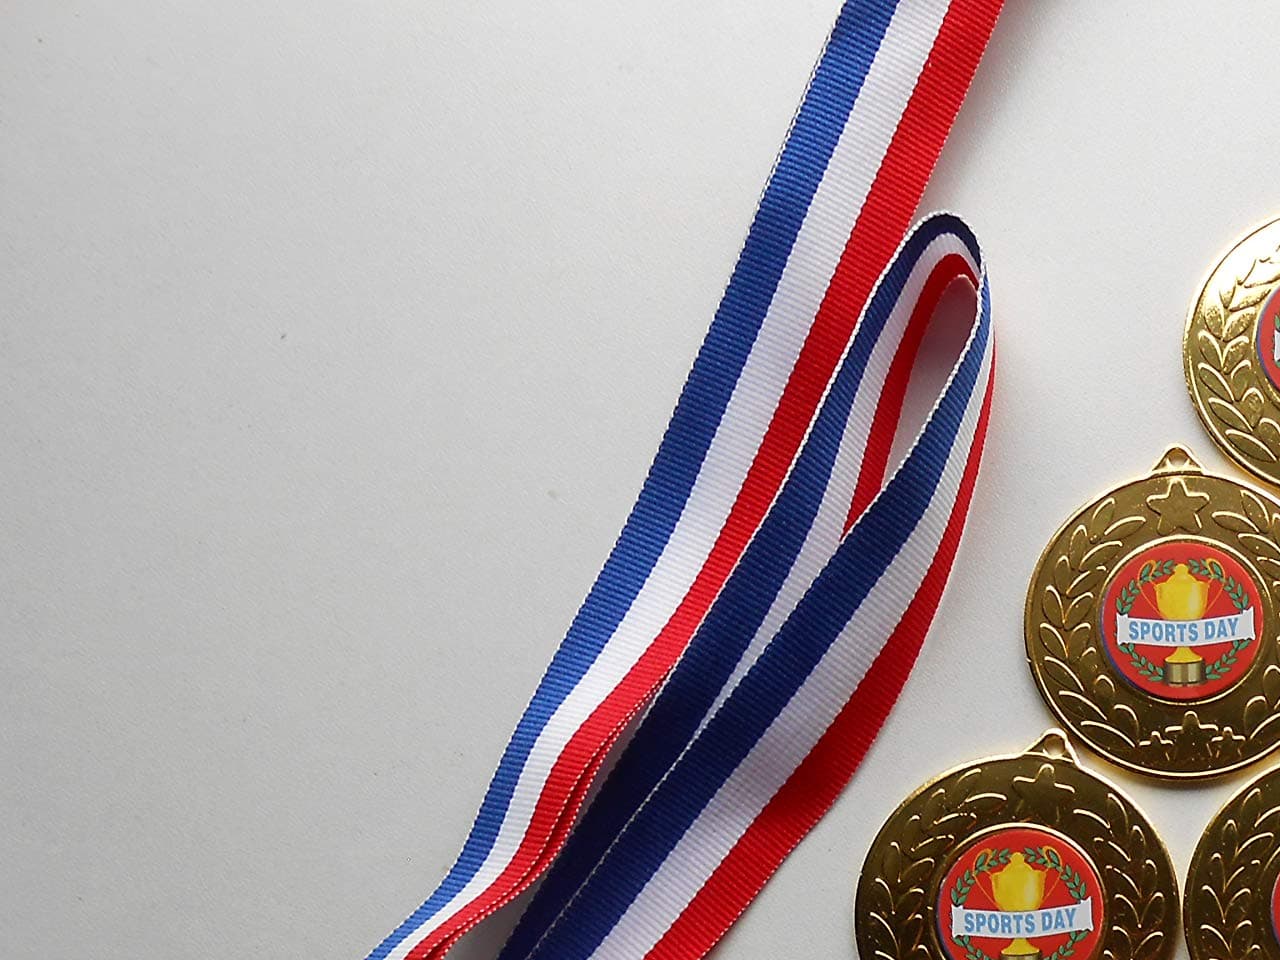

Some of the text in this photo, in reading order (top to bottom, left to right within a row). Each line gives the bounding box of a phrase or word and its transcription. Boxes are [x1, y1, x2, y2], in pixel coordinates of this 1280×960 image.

[1129, 618, 1240, 643] SPORTS DAY
[964, 908, 1077, 934] SPORTS DAY
